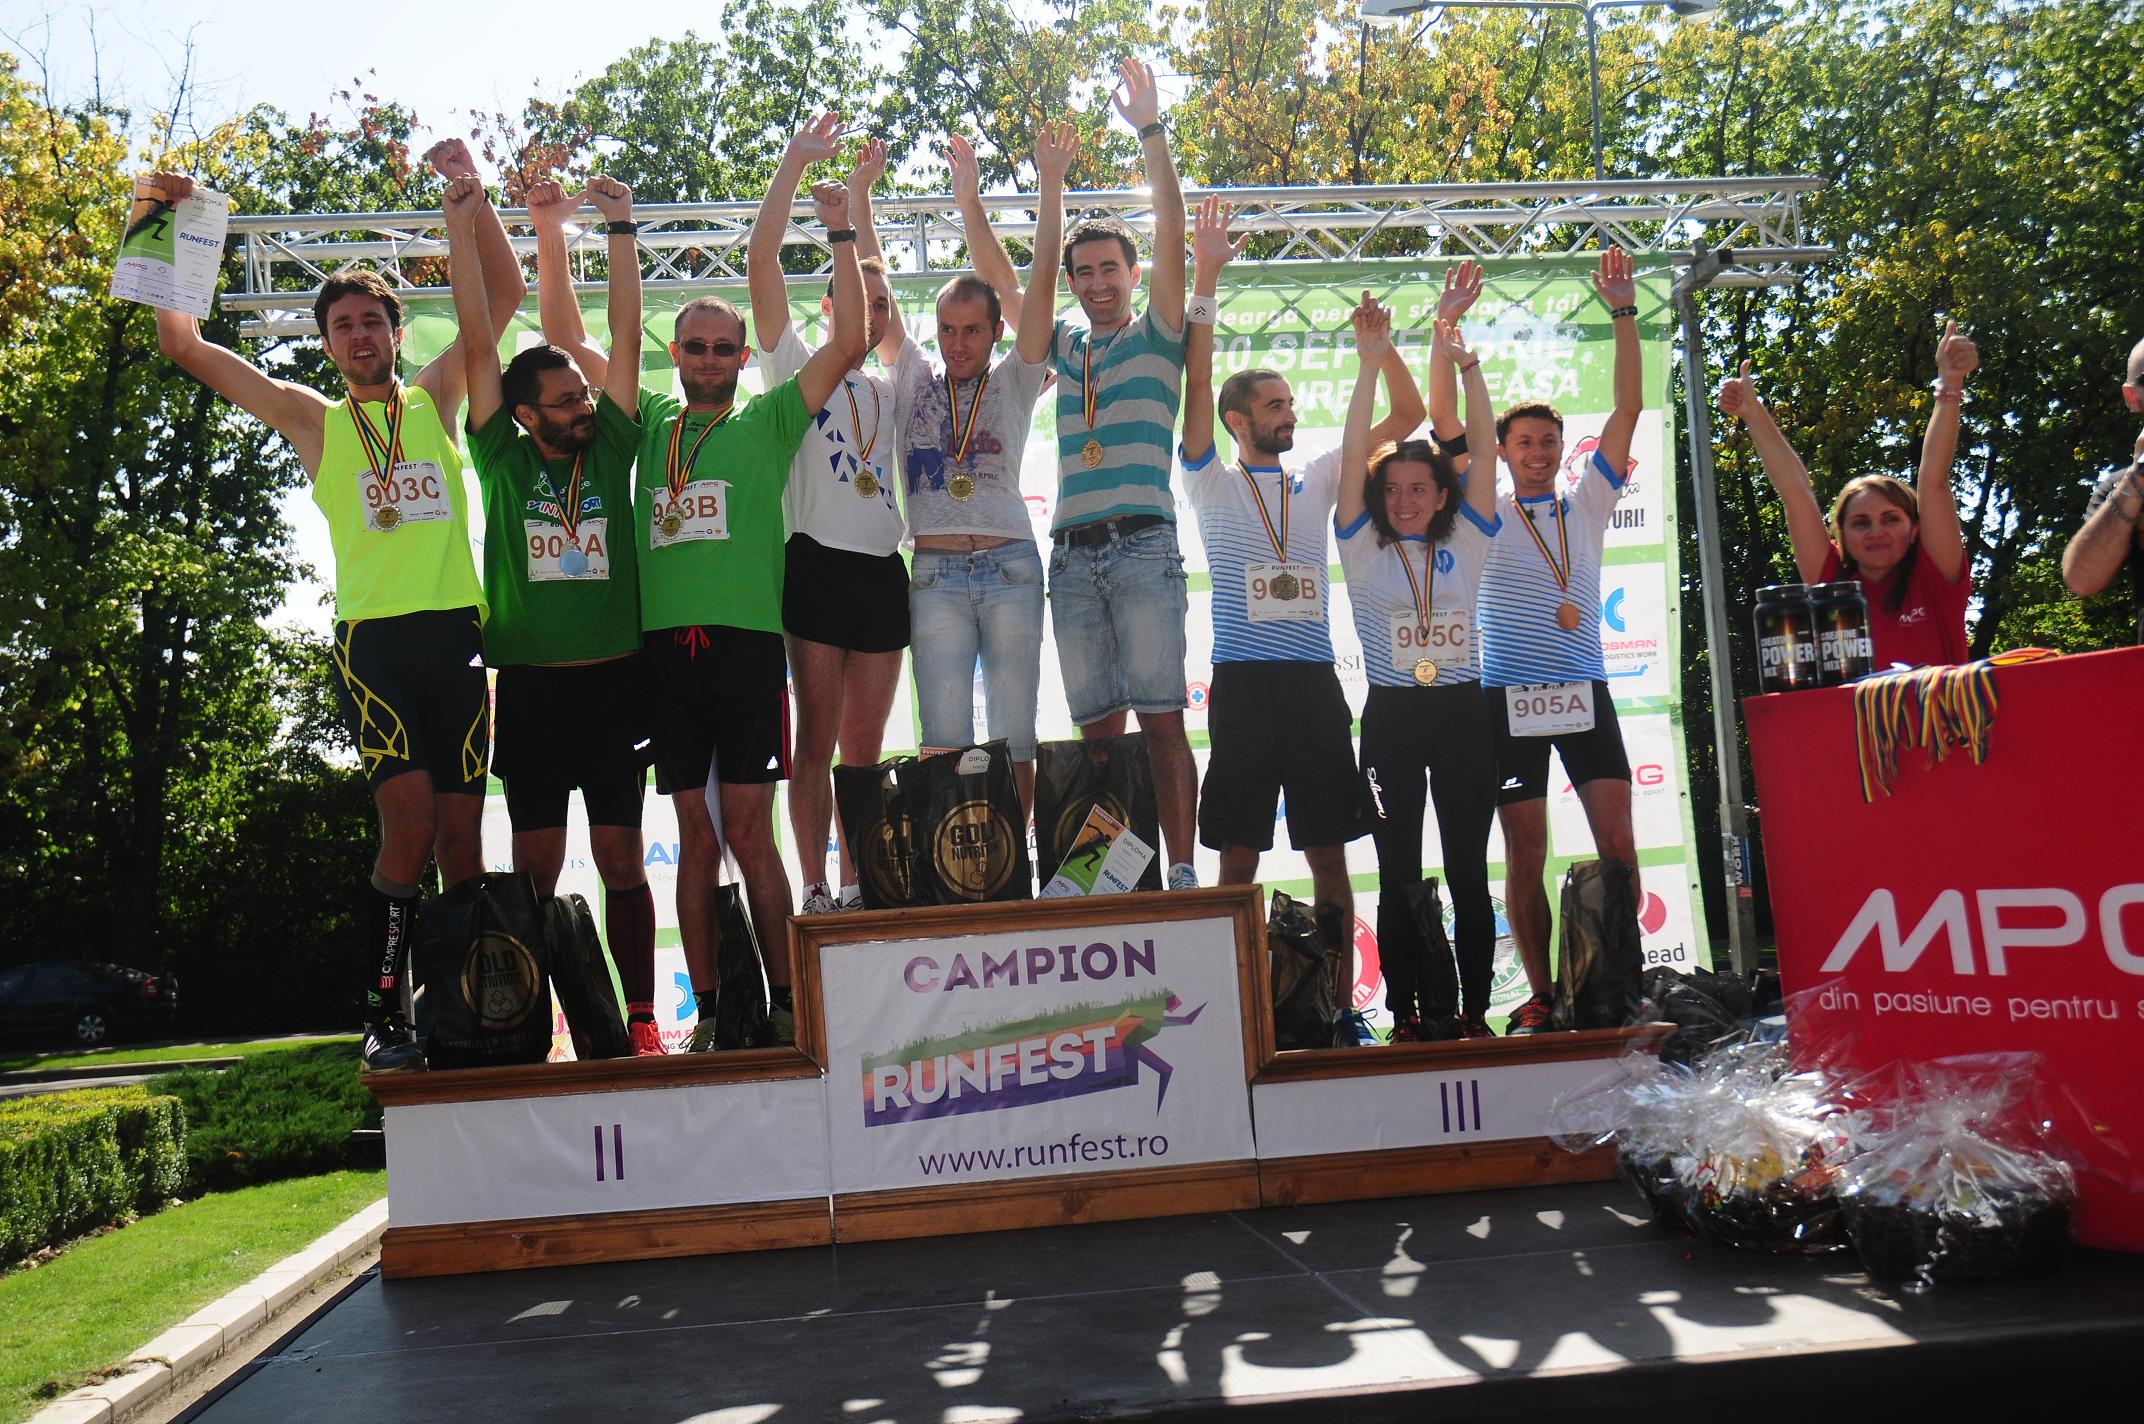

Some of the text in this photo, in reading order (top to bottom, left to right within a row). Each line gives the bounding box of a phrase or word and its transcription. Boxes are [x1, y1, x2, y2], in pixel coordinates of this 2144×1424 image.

[179, 232, 220, 248] RUNFEST
[394, 463, 417, 471] NFEST
[366, 475, 440, 508] 903C
[680, 483, 697, 493] FEST
[1610, 507, 1645, 530] URI!
[1252, 577, 1317, 600] 90B
[1397, 623, 1464, 648] 905C
[1604, 652, 1635, 660] OGISTICS
[1762, 642, 1815, 667] POWER
[1821, 637, 1873, 660] POWER
[1763, 665, 1778, 678] MIX
[1823, 659, 1840, 672] MIX
[1514, 694, 1587, 718] 905A
[1122, 838, 1146, 860] DIPLOMA
[1102, 869, 1128, 893] RUNFEST
[382, 904, 400, 974] COMPRESPORT
[480, 950, 517, 974] OLD
[904, 939, 1157, 993] CAMPION
[1819, 987, 1859, 1011] din
[1874, 988, 1992, 1016] pasiune
[2009, 995, 2119, 1022] pentru
[873, 1025, 1116, 1113] RUNFEST
[1440, 1079, 1481, 1133] III
[594, 1123, 624, 1182] II
[918, 1132, 1169, 1176] www.runfest.ro
